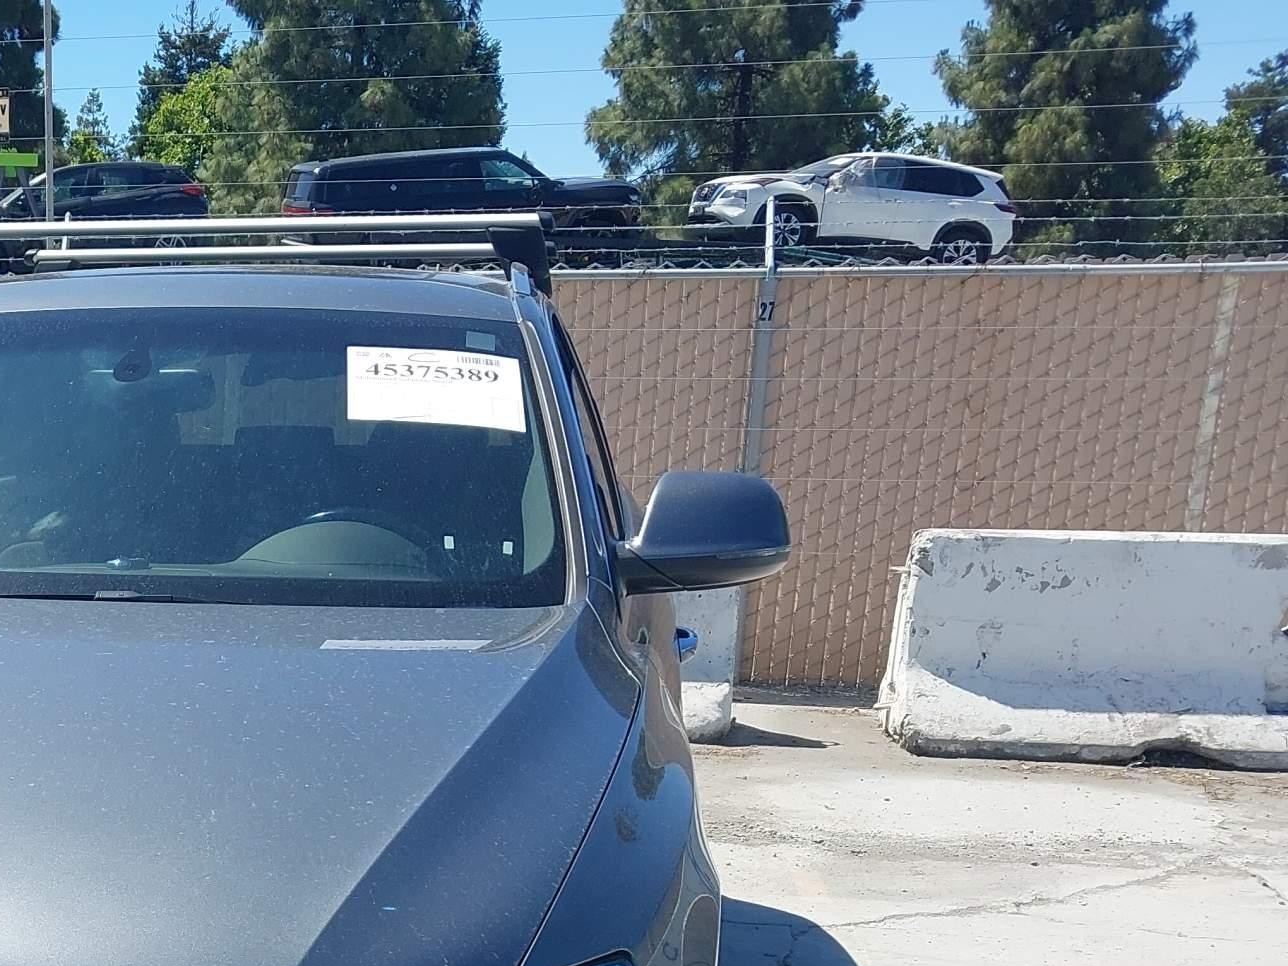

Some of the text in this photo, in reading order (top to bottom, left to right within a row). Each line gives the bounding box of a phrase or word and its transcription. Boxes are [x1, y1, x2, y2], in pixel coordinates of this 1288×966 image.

[0, 104, 6, 115] V
[760, 301, 775, 321] 27
[366, 362, 499, 383] 45375389
